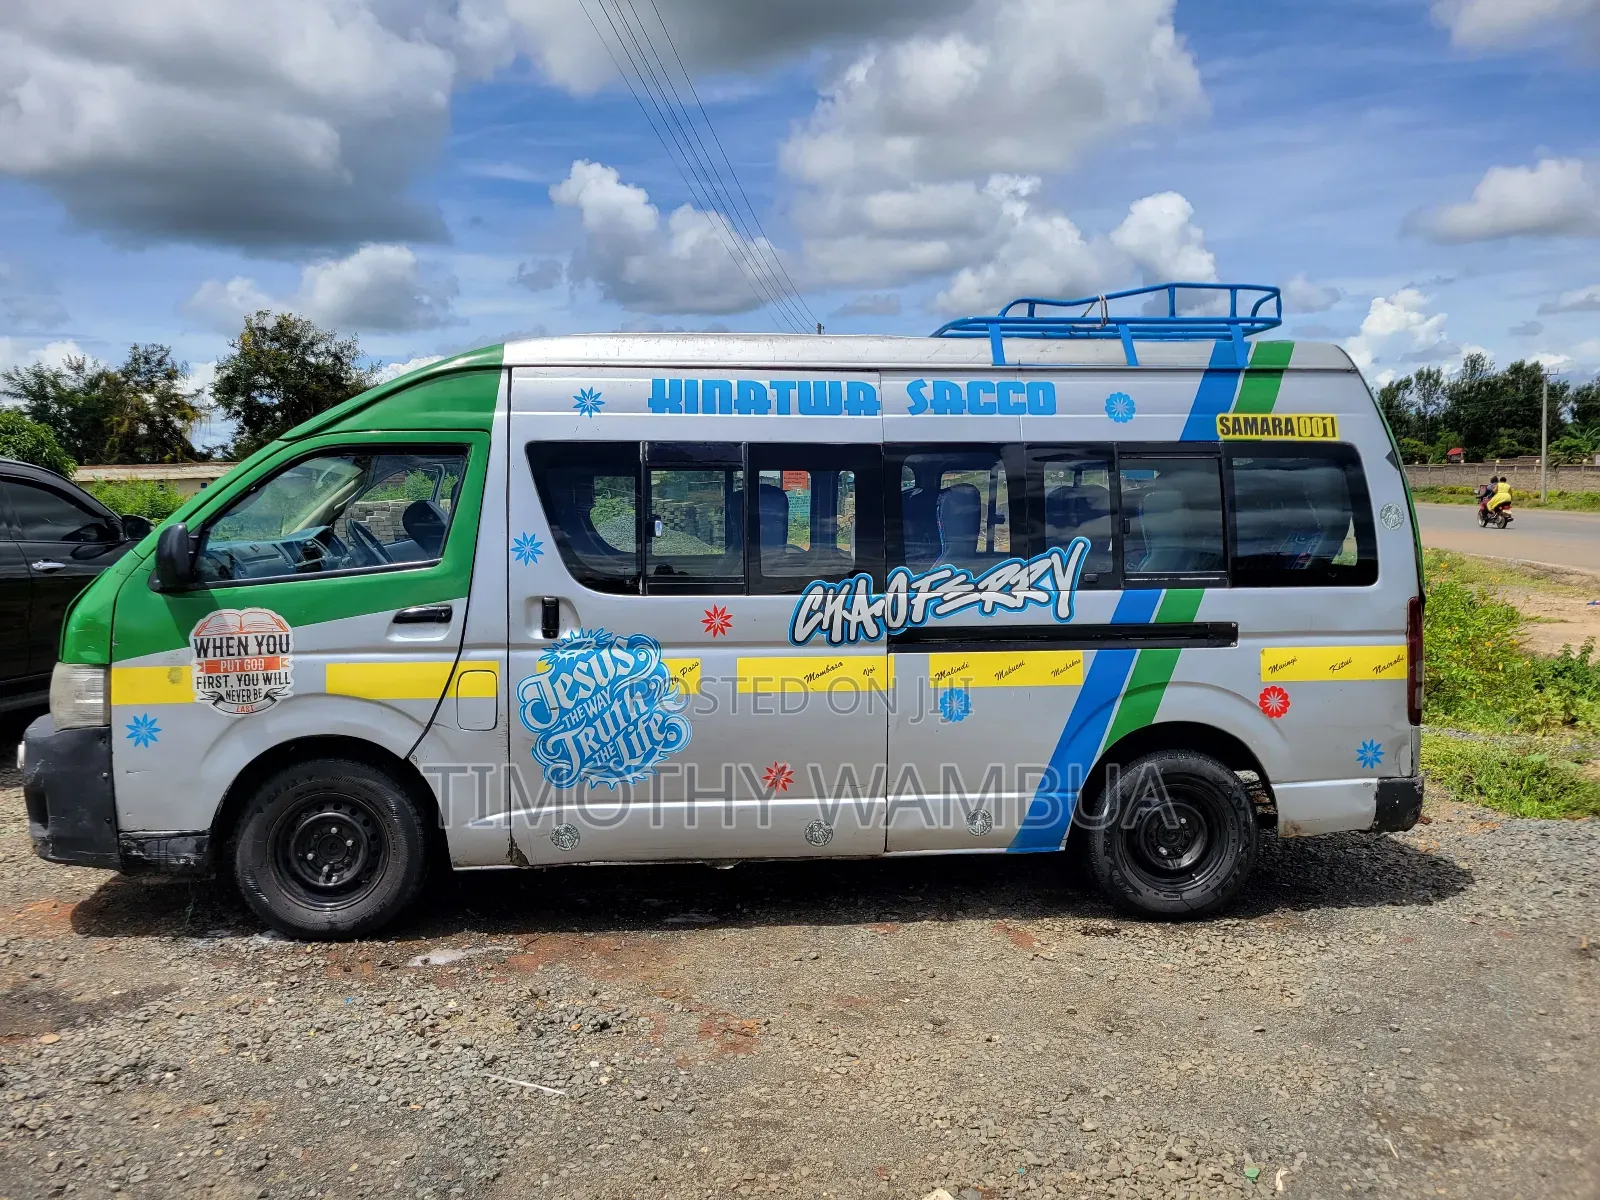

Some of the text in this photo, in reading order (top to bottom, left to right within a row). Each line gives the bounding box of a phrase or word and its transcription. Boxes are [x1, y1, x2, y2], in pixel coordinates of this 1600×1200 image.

[649, 378, 1057, 416] KINATWA SACCO
[1219, 416, 1335, 437] SAMARA 001
[194, 634, 290, 658] WHEN YOU
[220, 659, 264, 672] PUT GOD
[804, 661, 843, 684] Mombasa
[935, 658, 1081, 681] Malindi Makueni Machakos
[1329, 657, 1353, 673] Kitui
[1372, 654, 1405, 675] Nairobi
[196, 671, 290, 690] FIRST, YOU WILL
[226, 688, 262, 702] NEVER BE
[236, 704, 255, 712] LAST
[562, 686, 612, 729] THE WAY
[593, 741, 616, 766] THE
